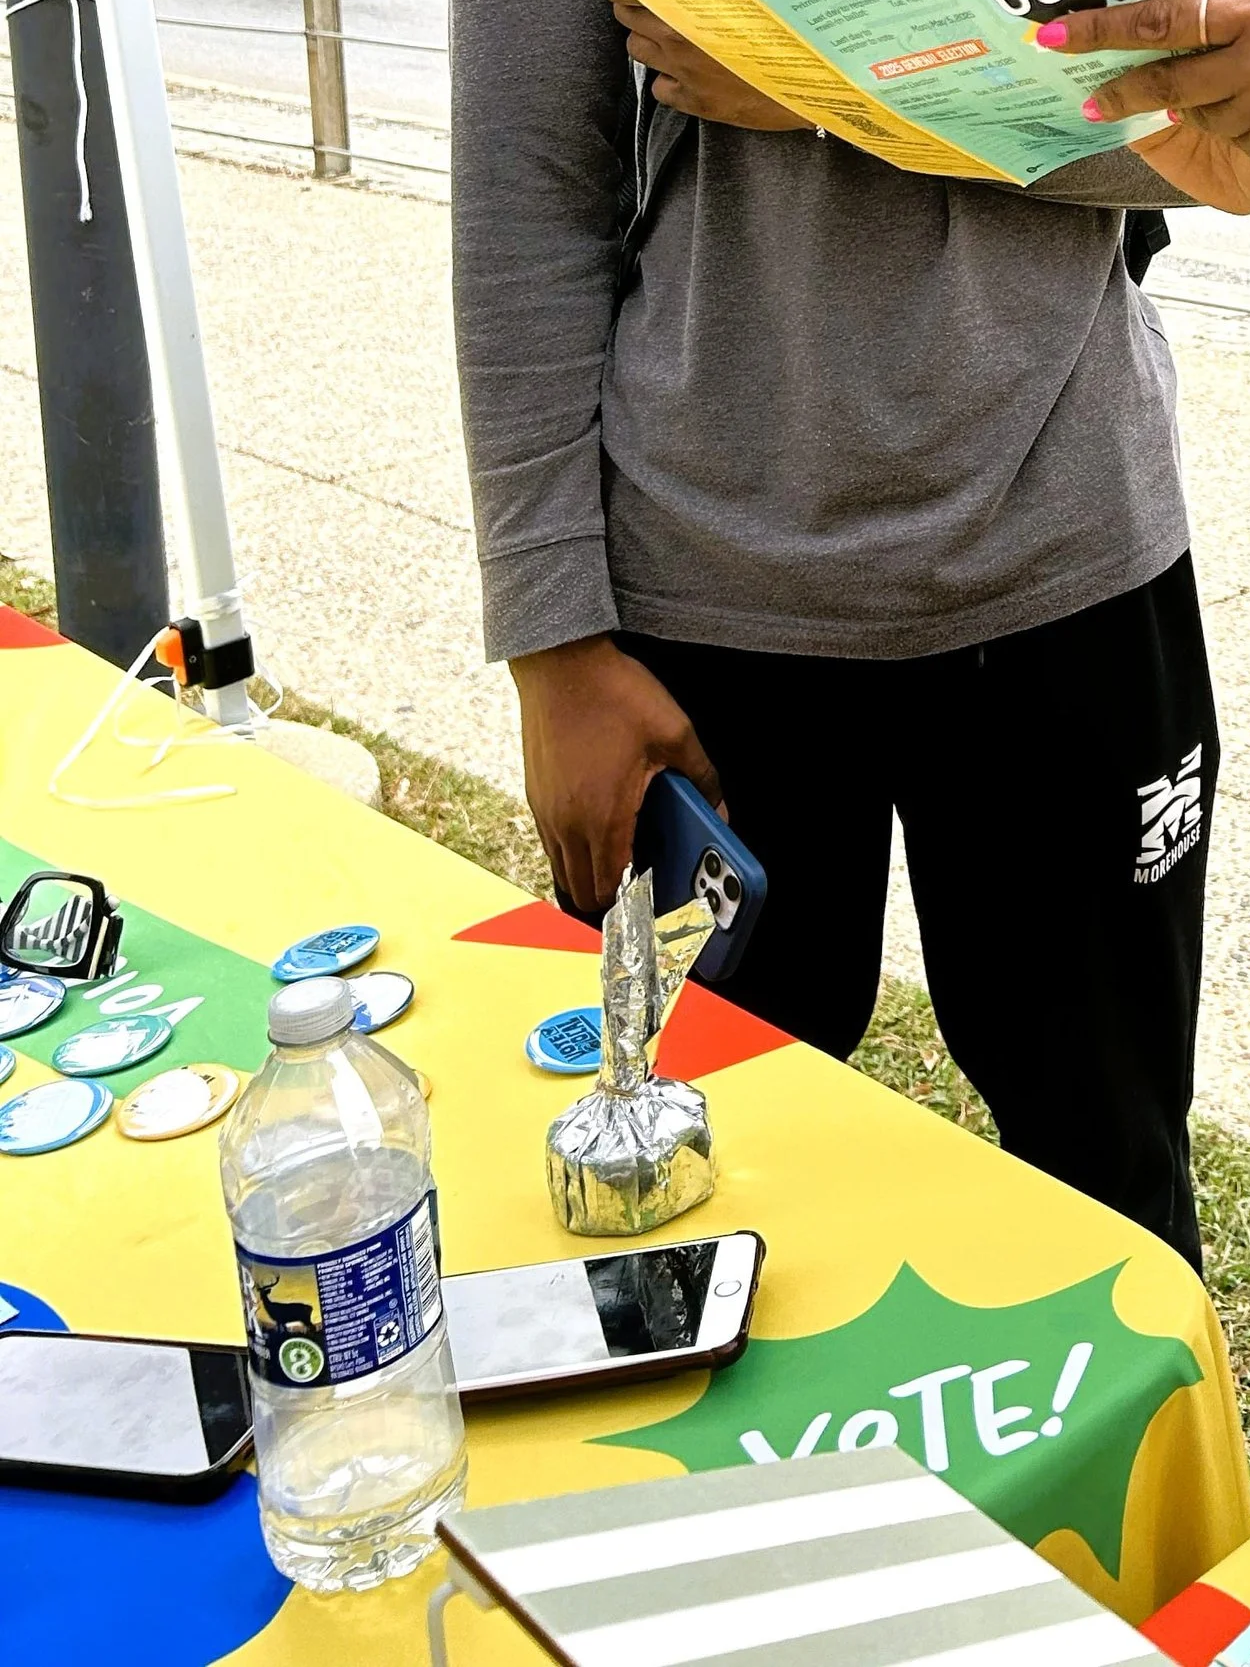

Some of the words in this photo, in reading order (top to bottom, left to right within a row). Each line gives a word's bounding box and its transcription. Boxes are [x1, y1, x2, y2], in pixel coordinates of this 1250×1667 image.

[901, 54, 941, 73] GENERAL
[940, 42, 982, 63] ELECTION
[1133, 822, 1202, 885] MOREHOUSE
[739, 1341, 1095, 1473] VOTE!
